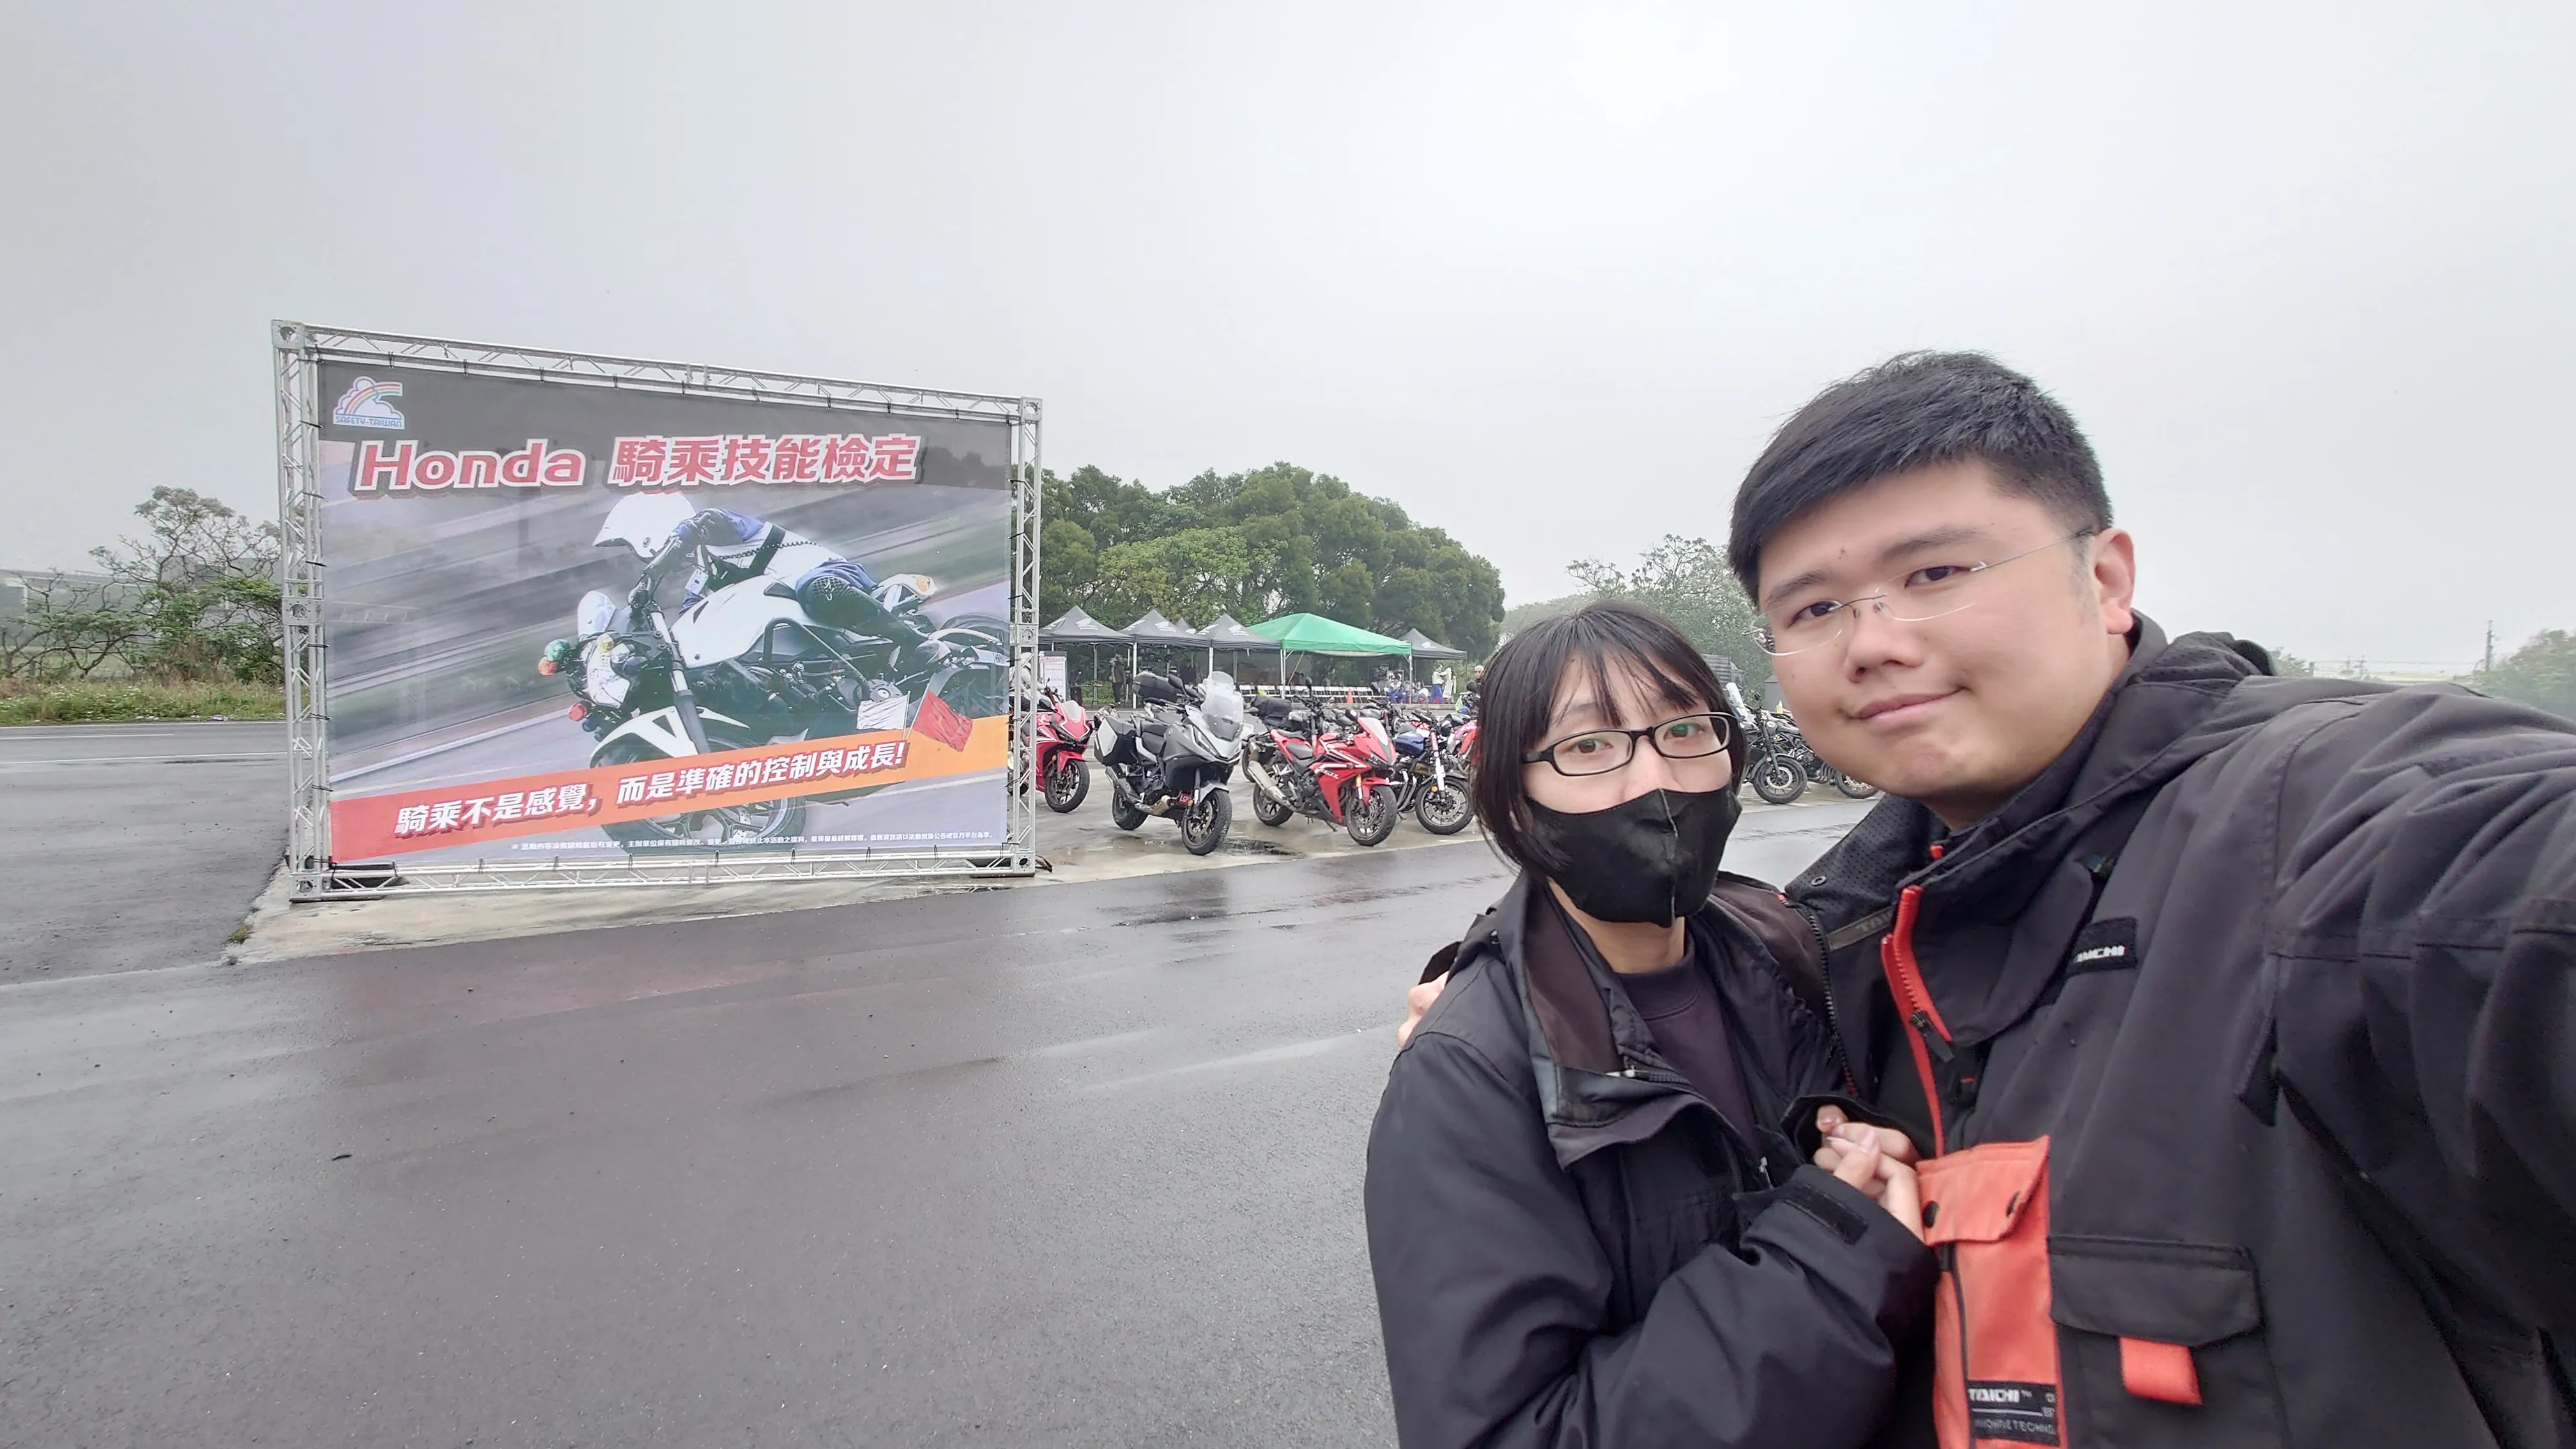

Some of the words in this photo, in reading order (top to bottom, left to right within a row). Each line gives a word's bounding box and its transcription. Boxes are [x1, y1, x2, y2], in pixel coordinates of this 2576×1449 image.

[356, 440, 584, 490] Honda
[611, 435, 919, 486] 騎乘技能檢定
